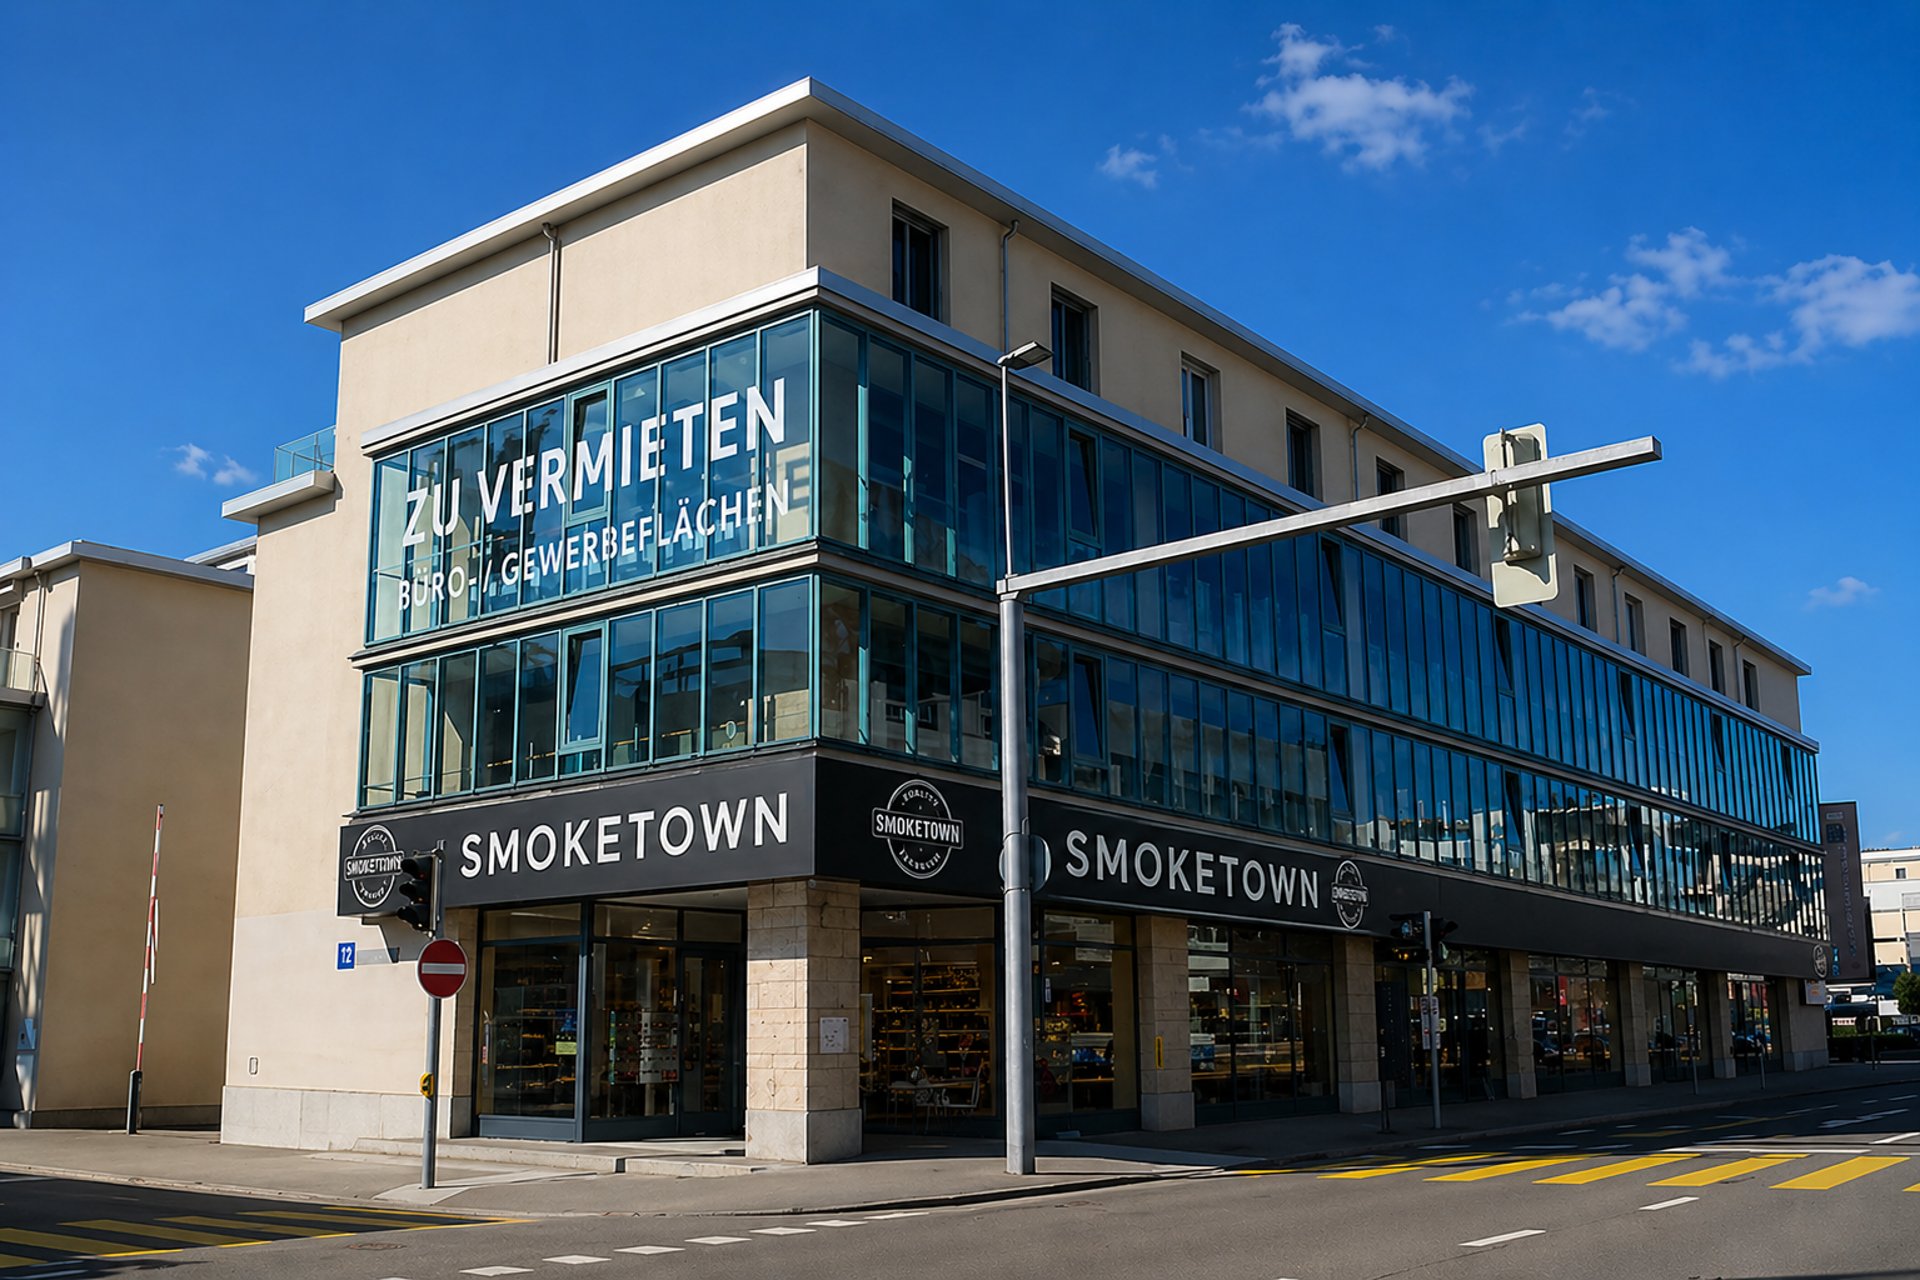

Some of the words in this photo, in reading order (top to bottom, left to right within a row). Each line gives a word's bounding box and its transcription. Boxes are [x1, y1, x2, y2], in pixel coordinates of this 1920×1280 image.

[402, 478, 461, 547] ZU
[477, 378, 785, 524] VERMIETEN
[398, 565, 477, 611] BÜRO-
[501, 479, 789, 586] GEWERBEFLÄCHEN
[460, 793, 788, 878] SMOKETOWN
[876, 814, 959, 844] SMOKETOWN
[1065, 829, 1319, 909] SMOKETOWN
[340, 946, 353, 964] 12
